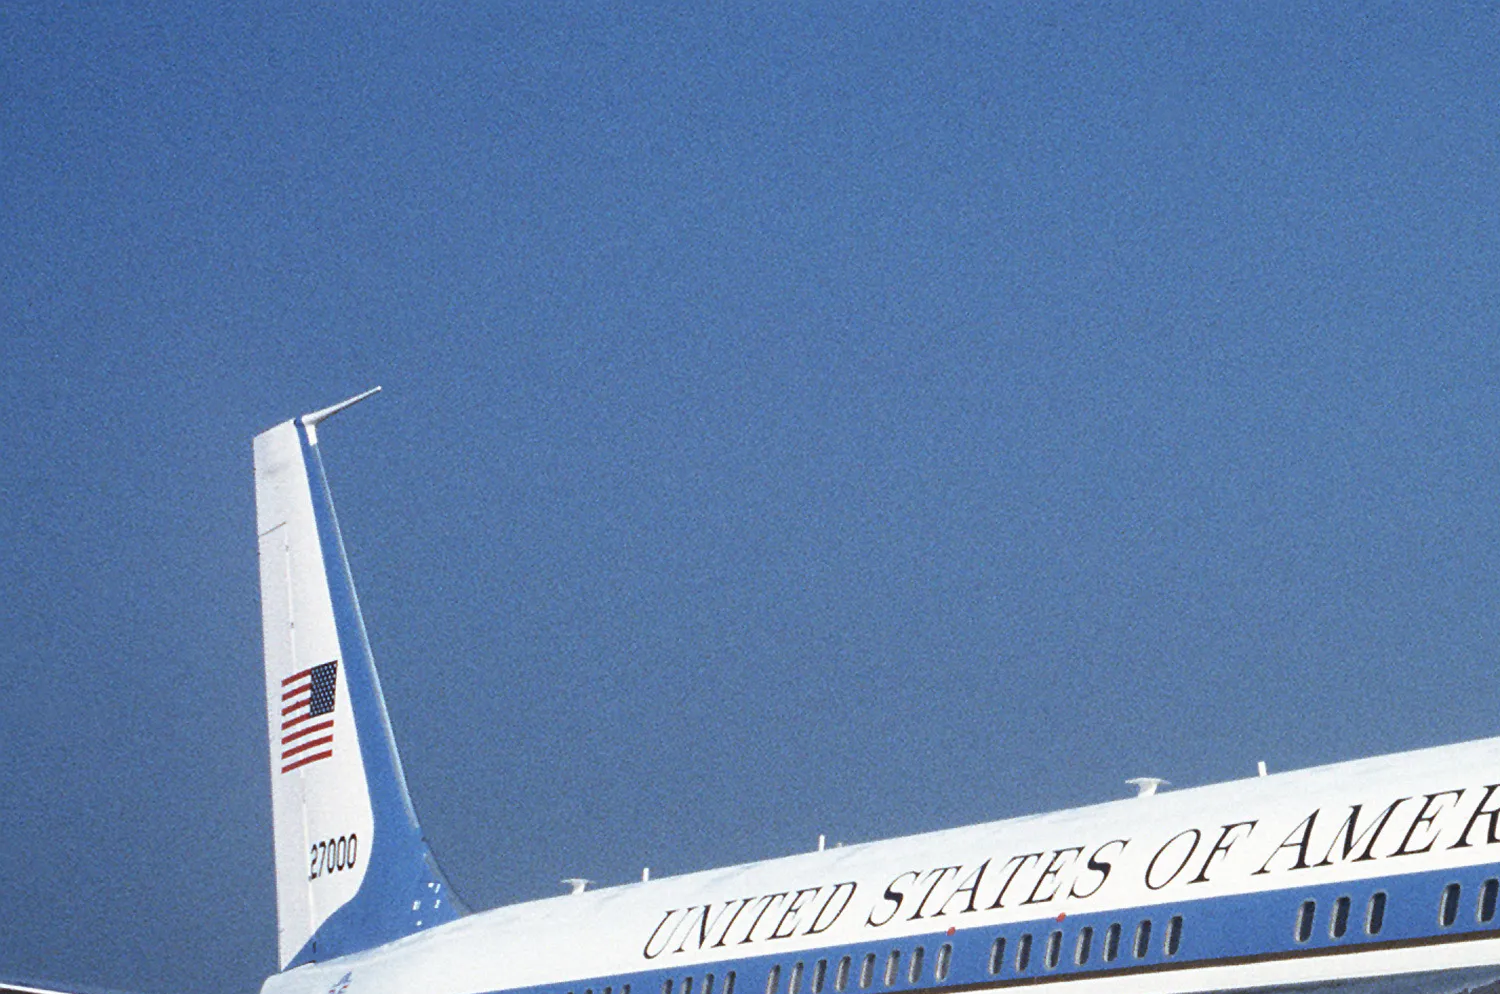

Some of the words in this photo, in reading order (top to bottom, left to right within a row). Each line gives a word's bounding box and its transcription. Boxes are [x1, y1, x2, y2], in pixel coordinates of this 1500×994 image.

[310, 832, 358, 881] 27000
[643, 881, 857, 960] UNITED
[864, 838, 1132, 928] STATES
[1144, 819, 1259, 891] OF
